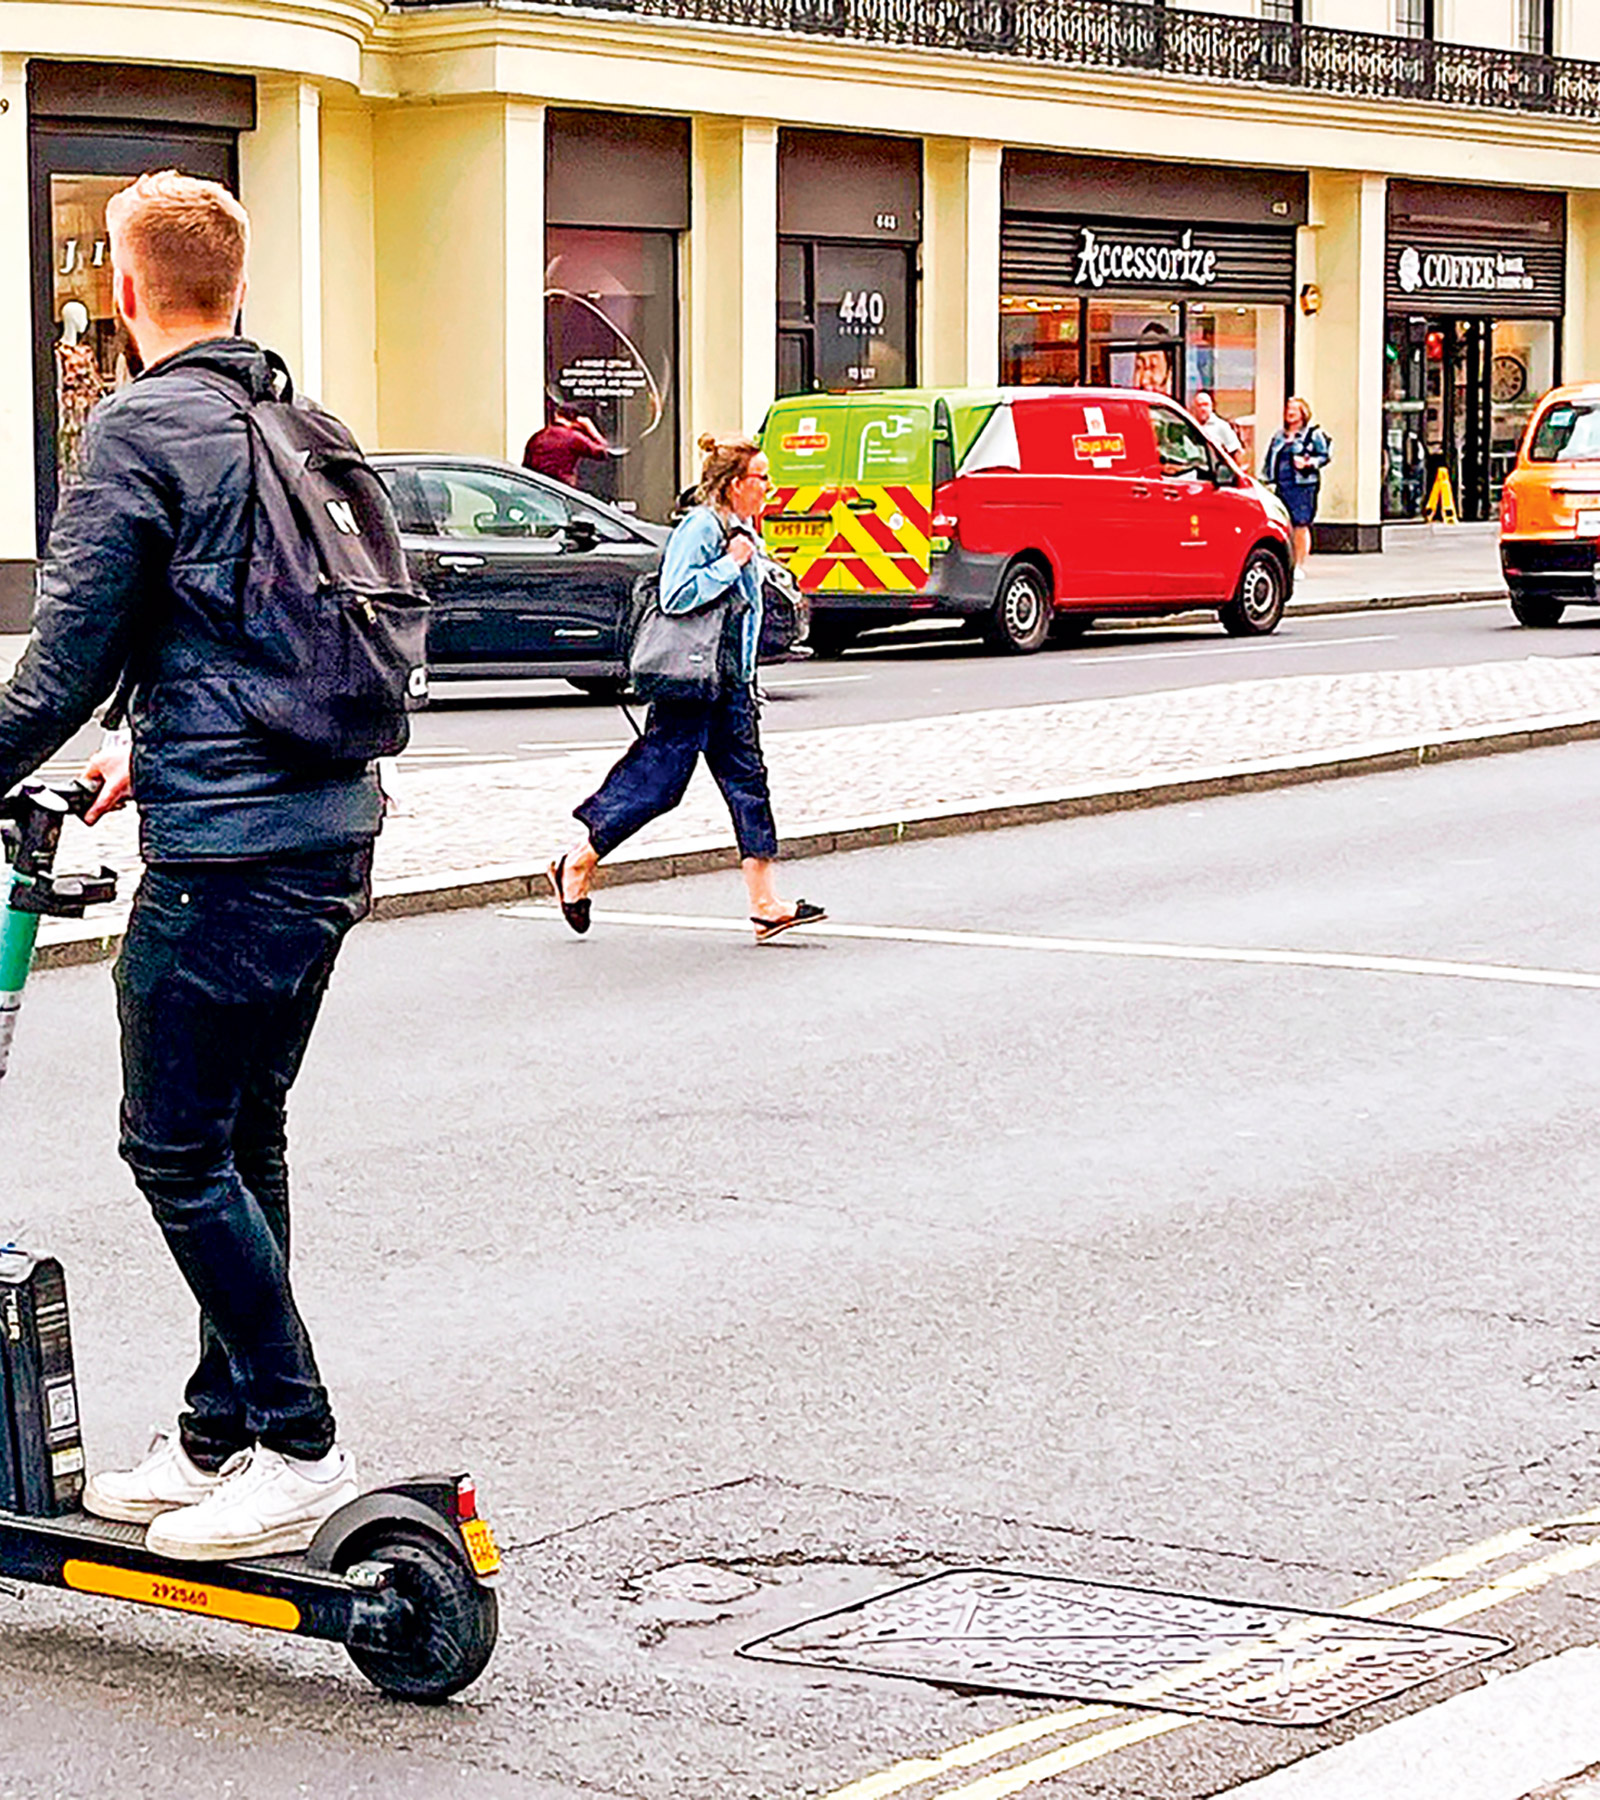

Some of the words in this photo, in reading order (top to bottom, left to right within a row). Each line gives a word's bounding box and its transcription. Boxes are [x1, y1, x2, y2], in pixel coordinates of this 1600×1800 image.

[1075, 228, 1216, 287] Accessorize
[1423, 254, 1496, 289] COFFEE
[839, 291, 884, 324] 440
